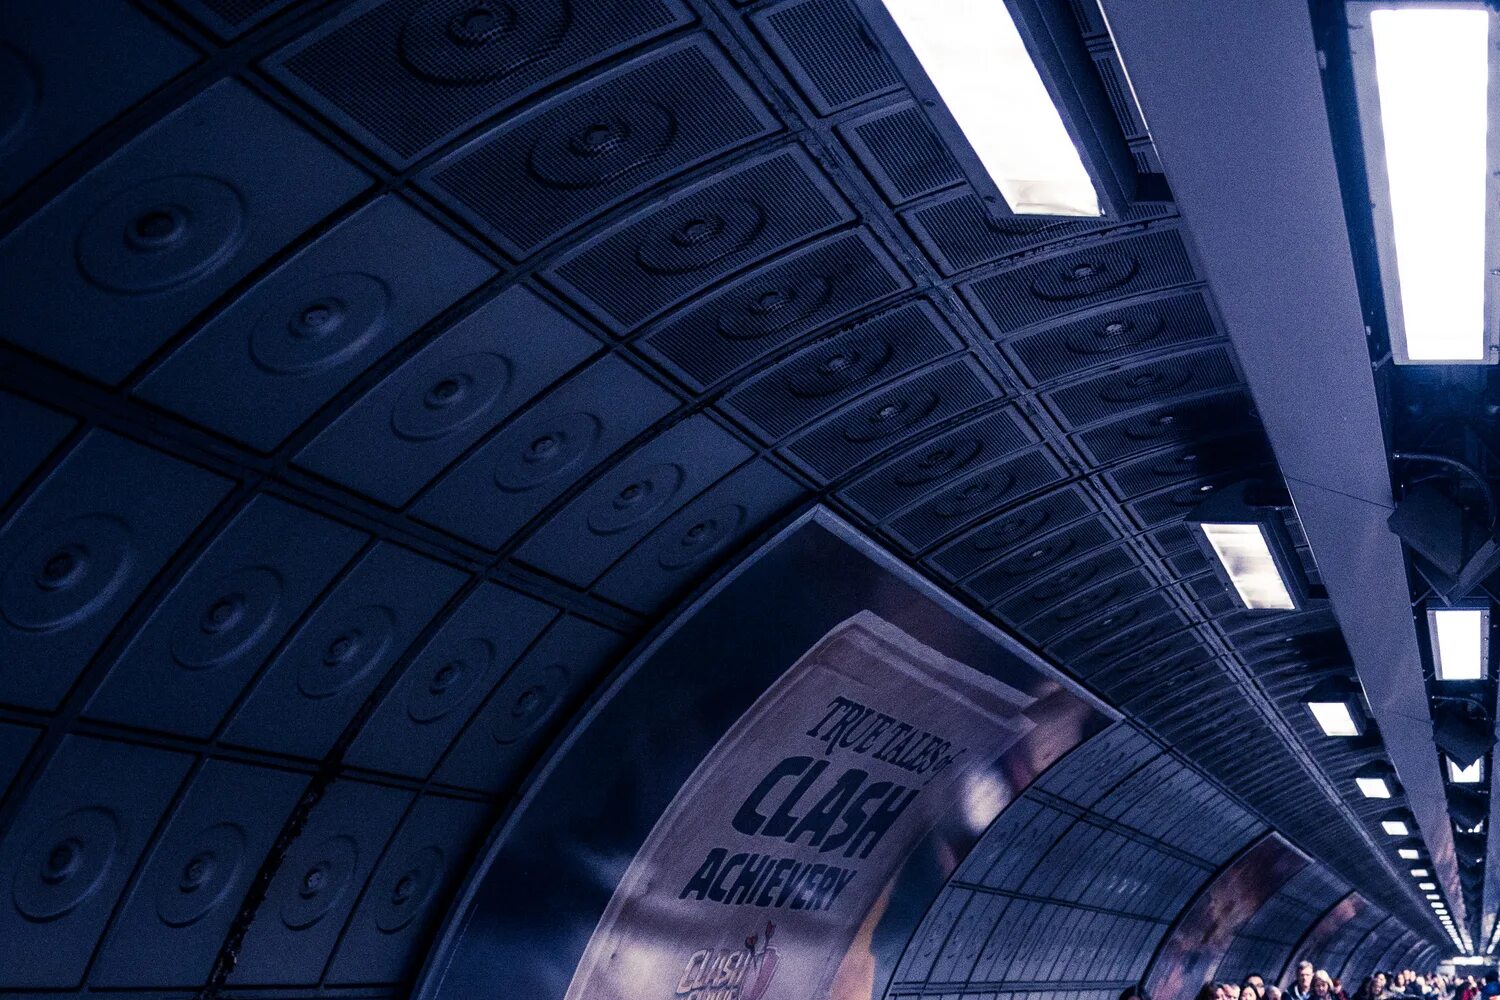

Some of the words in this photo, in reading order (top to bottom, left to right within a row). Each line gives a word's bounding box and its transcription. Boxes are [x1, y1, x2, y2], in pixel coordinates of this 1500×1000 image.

[806, 695, 897, 755] TRUE
[872, 721, 951, 774] TALES
[731, 755, 920, 859] CLASH
[678, 847, 858, 911] ACHIEVERY
[676, 949, 750, 995] CLASH
